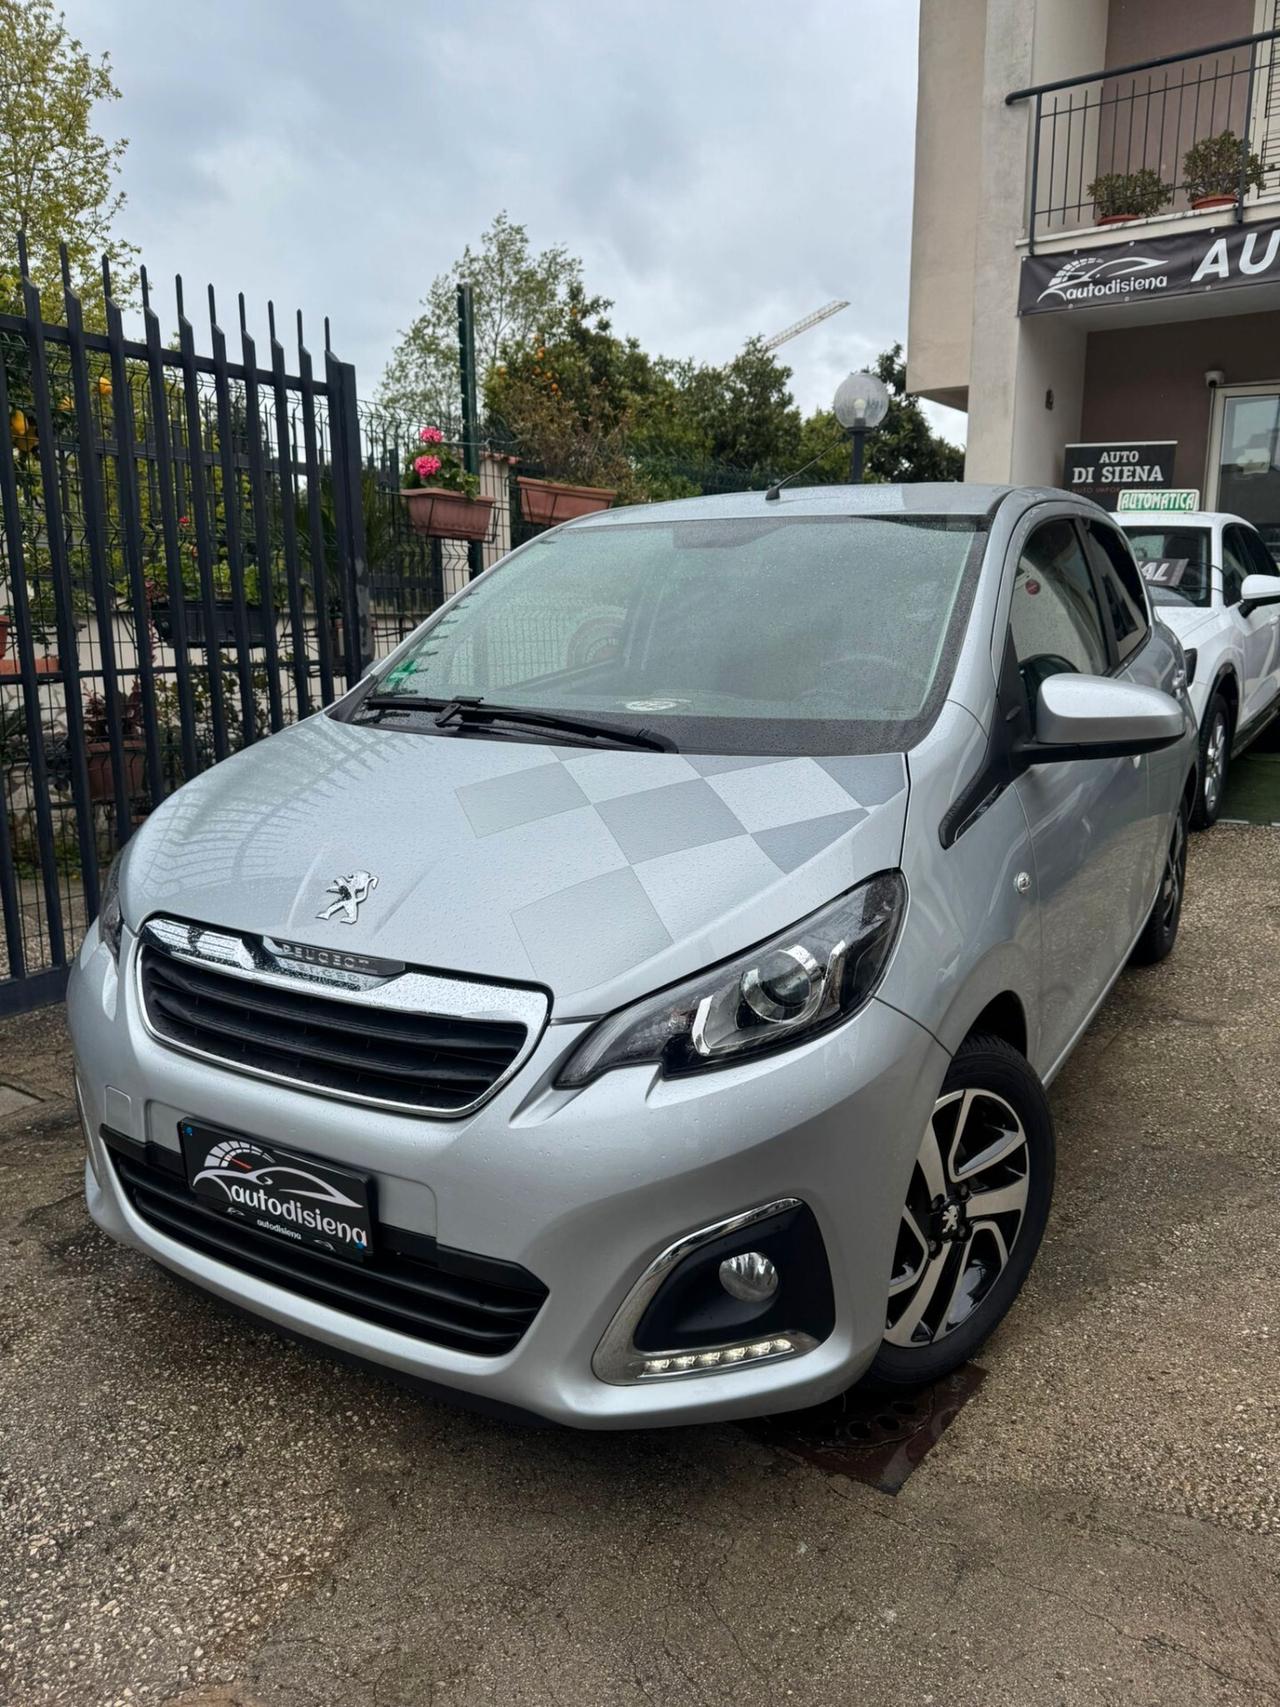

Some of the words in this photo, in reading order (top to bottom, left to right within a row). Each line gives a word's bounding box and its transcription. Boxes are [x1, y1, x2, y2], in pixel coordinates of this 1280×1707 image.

[1066, 275, 1168, 299] autodisiena
[1190, 229, 1280, 283] AU
[1099, 450, 1140, 464] AUTO
[1072, 467, 1095, 483] DI
[1101, 465, 1164, 483] SIENA
[1121, 492, 1195, 511] AUTOMATICA
[1138, 561, 1171, 582] AL
[281, 943, 370, 969] PEUGEOT
[231, 1184, 368, 1247] autodisiena
[257, 1219, 302, 1240] autodisiena
